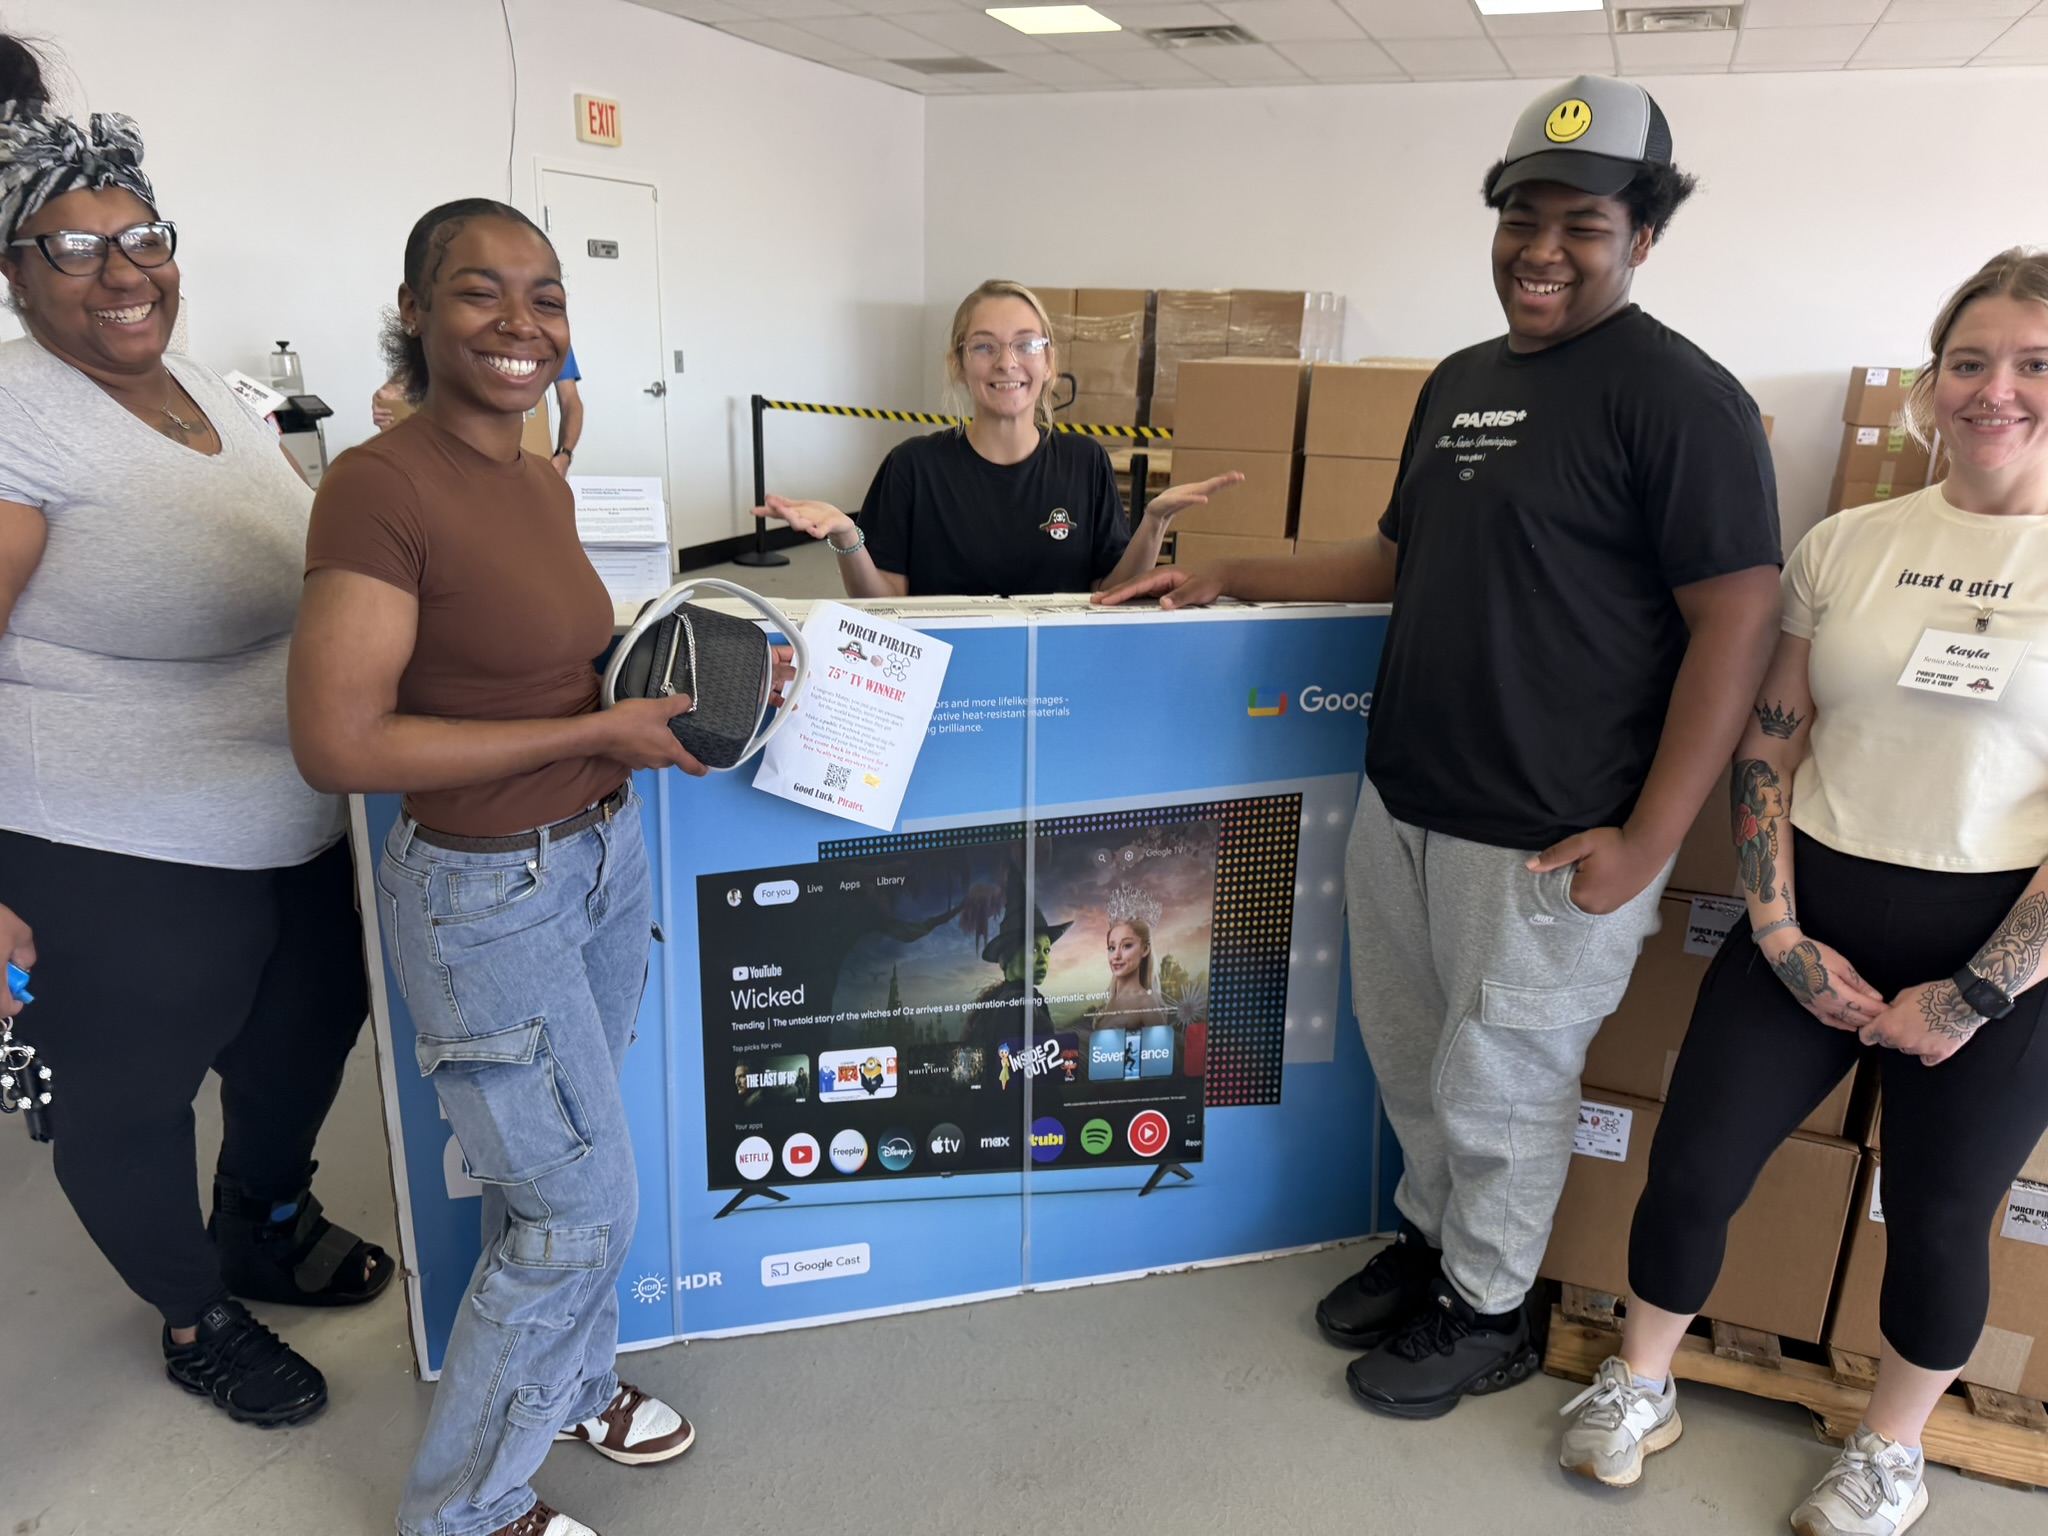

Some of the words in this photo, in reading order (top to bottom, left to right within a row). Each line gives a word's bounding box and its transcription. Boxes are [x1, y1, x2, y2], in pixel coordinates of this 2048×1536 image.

[588, 101, 615, 138] EXIT
[1435, 436, 1451, 448] The
[1895, 569, 1945, 589] just
[1949, 579, 1964, 592] a
[1965, 580, 2014, 599] girl
[838, 619, 878, 644] PORCH
[878, 634, 923, 660] PIRATES
[1946, 645, 1990, 659] Kayla
[1924, 656, 1945, 665] Senior
[1947, 660, 1964, 668] Sales
[1965, 662, 1999, 673] Associate
[1916, 670, 1936, 679] PORCH
[1936, 673, 1959, 682] PIRATES
[850, 673, 864, 687] TV
[865, 678, 906, 702] WINNER!
[1915, 677, 1930, 685] STAFF
[1937, 680, 1953, 688] CREW
[951, 698, 969, 708] and
[972, 698, 996, 707] more
[998, 696, 1028, 706] lifelike
[1031, 696, 1063, 706] mages
[962, 709, 1026, 720] heat-resistant
[939, 723, 983, 733] brilliance.
[793, 782, 814, 797] Good
[837, 797, 864, 812] Pirates.
[1145, 847, 1172, 858] Google
[1174, 846, 1183, 854] TV
[840, 880, 861, 891] Apps
[877, 876, 905, 887] Library
[762, 889, 775, 898] For
[776, 888, 791, 899] you
[807, 884, 823, 894] Live
[749, 964, 782, 979] YouTube
[730, 984, 805, 1011] Wicked
[731, 1020, 765, 1031] Trending
[773, 1018, 787, 1027] The
[788, 1015, 813, 1026] untold
[815, 1013, 835, 1025] story
[836, 1012, 844, 1021] of
[846, 1011, 859, 1020] the
[861, 1008, 891, 1019] witches
[892, 1007, 901, 1016] of
[902, 1006, 914, 1016] Oz
[916, 1005, 942, 1015] arrives
[961, 996, 1043, 1013] generation-defing
[1044, 992, 1085, 1004] cinematic
[1086, 991, 1110, 1000] event
[744, 1044, 760, 1052] picks
[771, 1042, 782, 1050] you
[1009, 1045, 1047, 1072] INSIDE
[1044, 1039, 1064, 1069] 2
[1025, 1058, 1047, 1079] OUT
[746, 1073, 759, 1088] THE
[760, 1071, 777, 1087] LAST
[778, 1071, 787, 1085] OF
[787, 1070, 797, 1085] US
[749, 1122, 763, 1130] apps
[944, 1137, 960, 1153] tv
[981, 1137, 1010, 1149] max
[833, 1147, 864, 1156] Freeplay
[739, 1153, 769, 1164] NETFLIX
[2009, 1204, 2035, 1215] PORCH
[793, 1258, 833, 1273] Google
[836, 1255, 860, 1267] Cast
[641, 1283, 657, 1291] HDR
[676, 1271, 722, 1291] HDR
